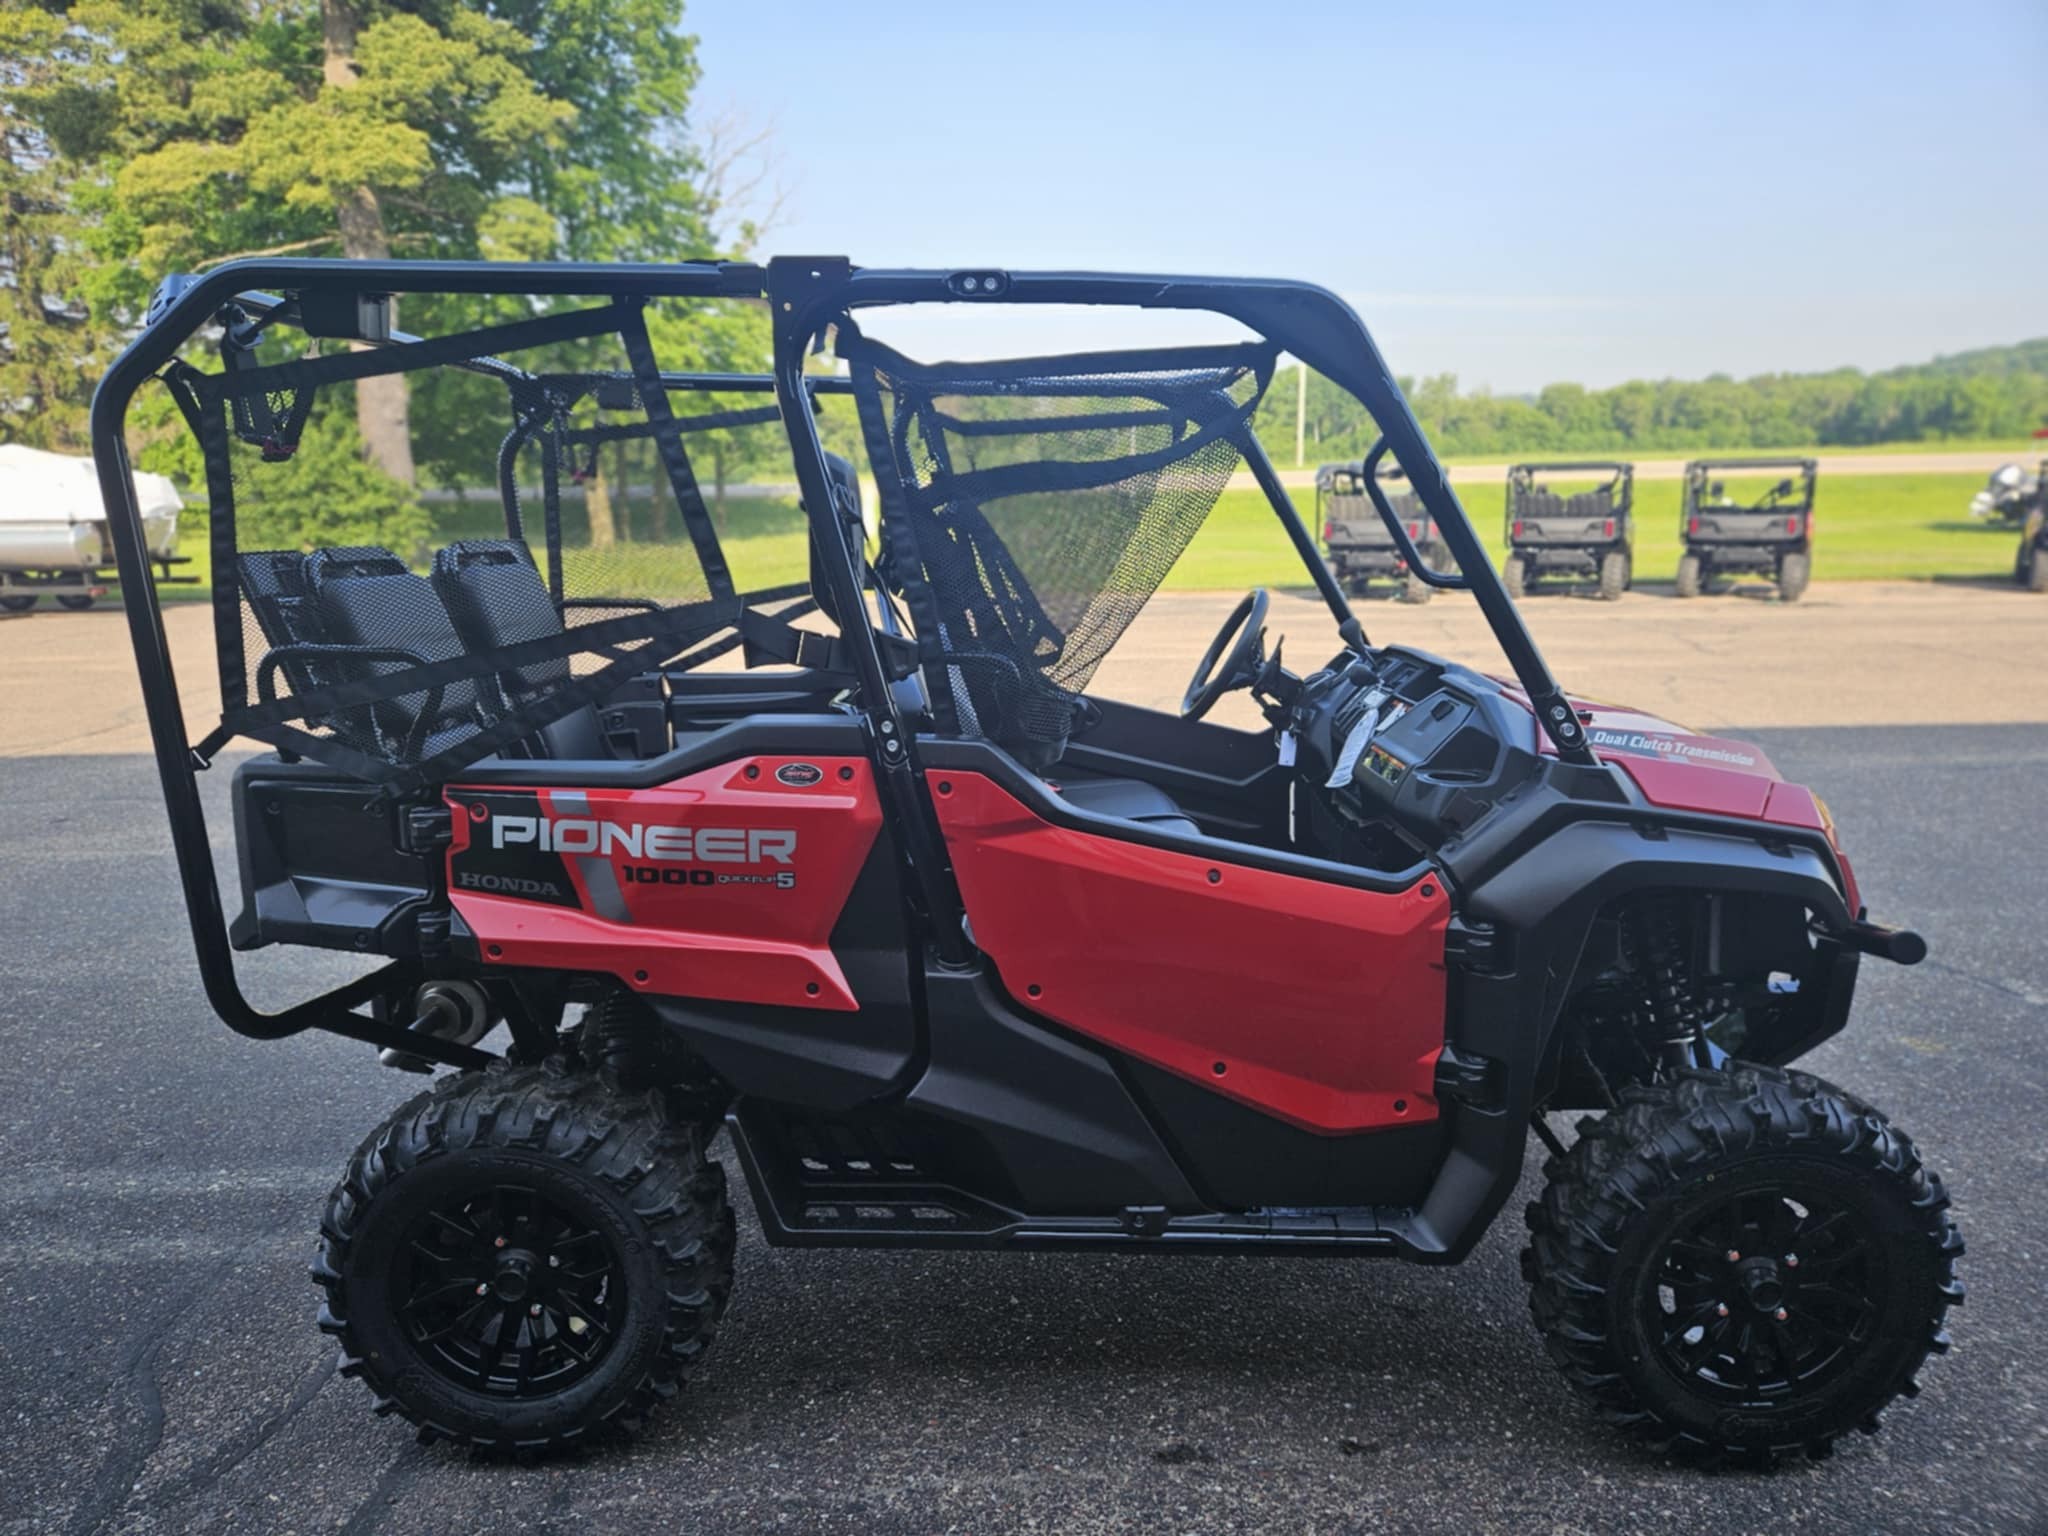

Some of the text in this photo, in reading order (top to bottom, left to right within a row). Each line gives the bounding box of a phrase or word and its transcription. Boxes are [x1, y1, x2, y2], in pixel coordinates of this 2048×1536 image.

[1594, 731, 1755, 766] Dual Clutch Transmission
[492, 814, 797, 864] PIONEER
[459, 871, 561, 896] HONDA
[622, 865, 714, 886] 1000
